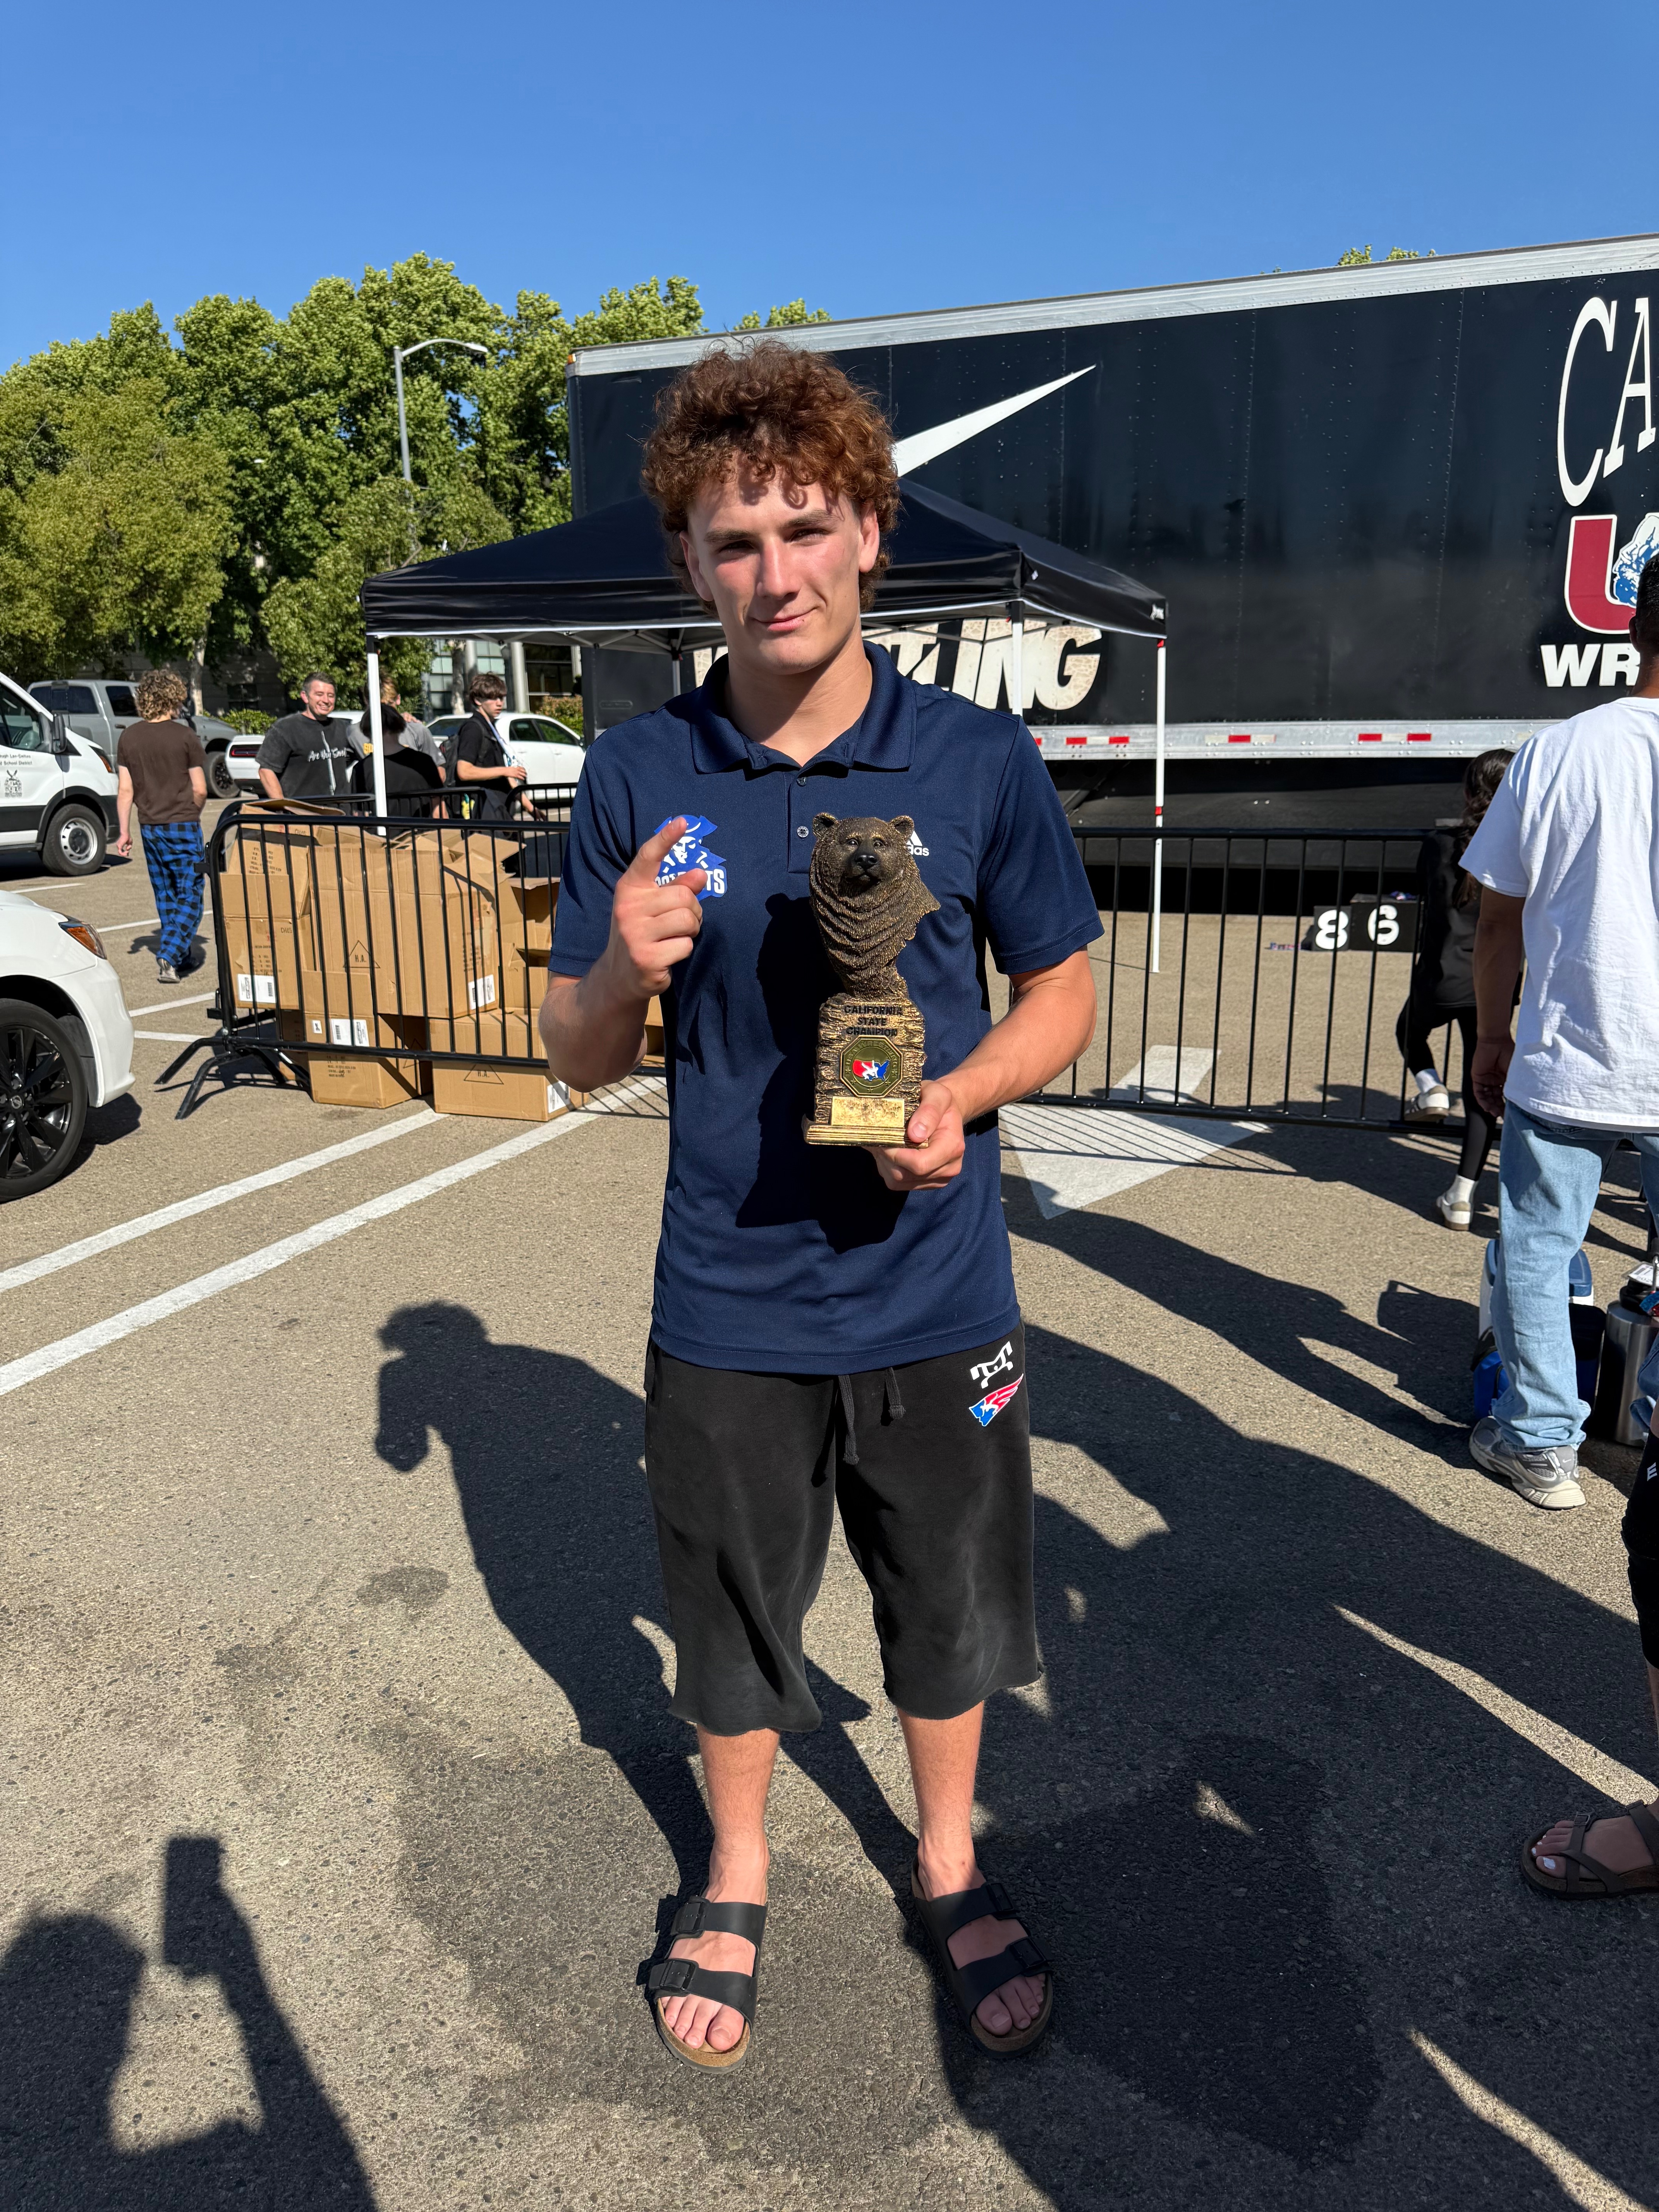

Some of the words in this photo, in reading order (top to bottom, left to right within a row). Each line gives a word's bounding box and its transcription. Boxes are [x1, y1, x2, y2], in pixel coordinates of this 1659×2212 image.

[908, 845, 929, 856] das
[1316, 910, 1349, 949] 8
[1368, 905, 1399, 945] 6
[844, 1005, 903, 1015] CALIFORNIA
[858, 1017, 887, 1026] STATE
[847, 1027, 898, 1036] CHAMPION
[845, 1049, 858, 1065] USA
[856, 1041, 898, 1067] WRESTLING
